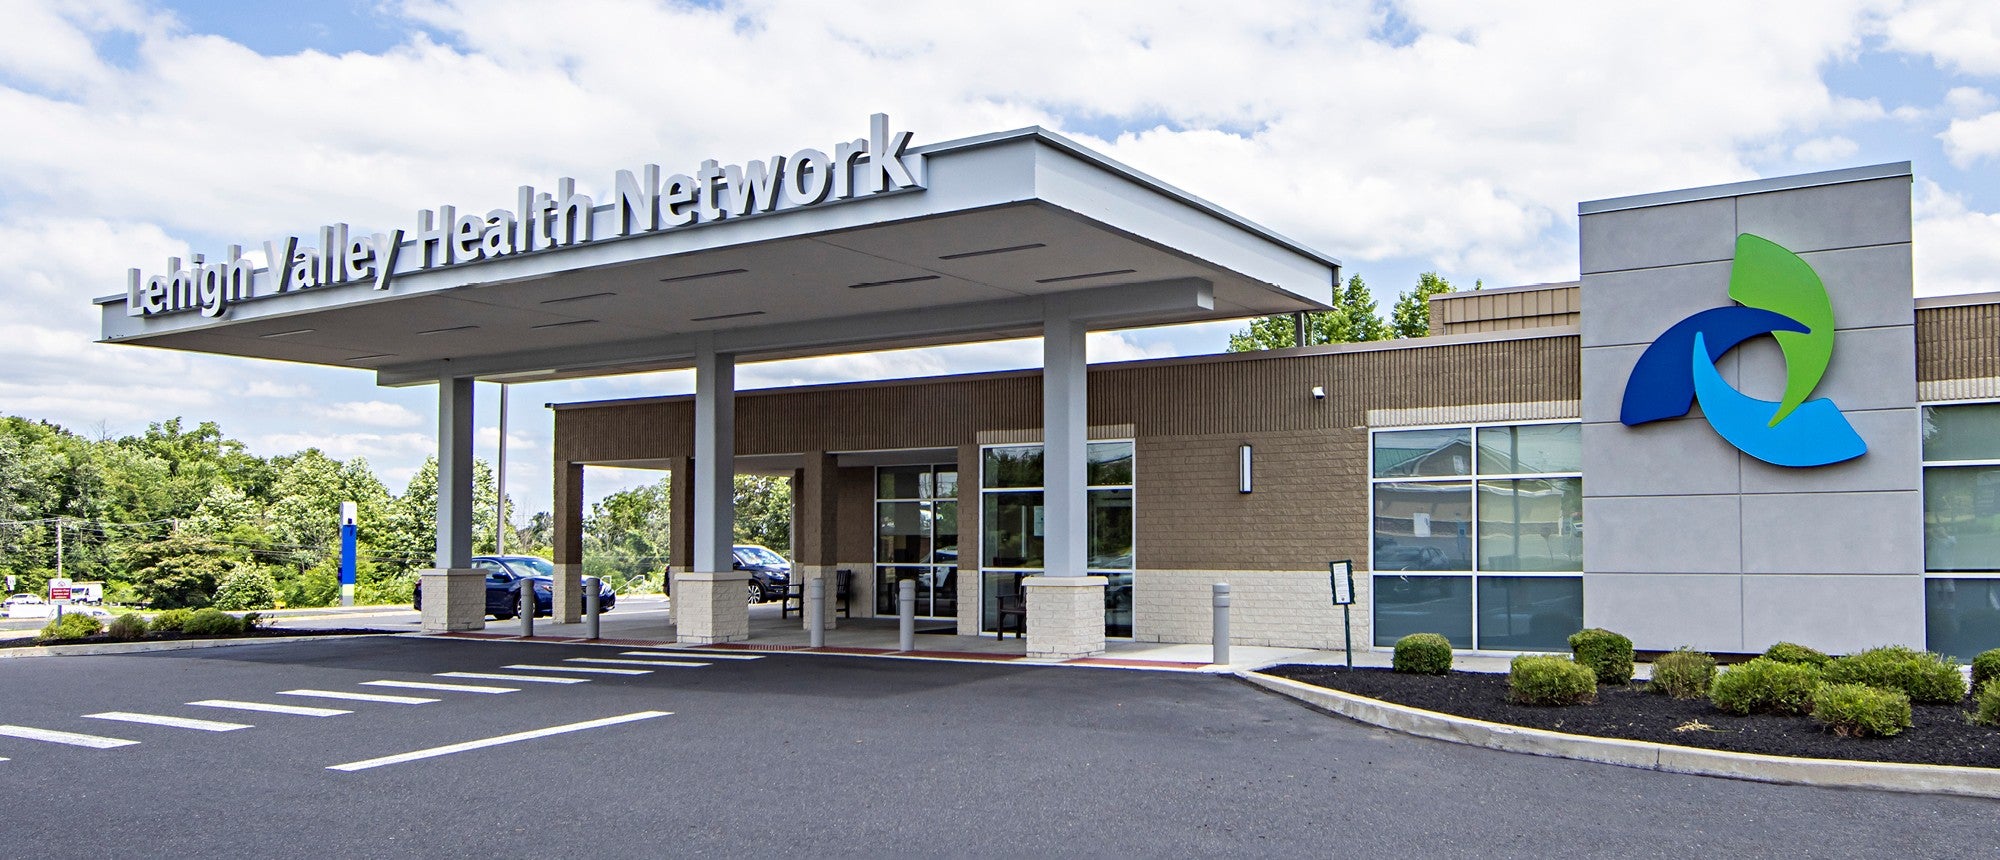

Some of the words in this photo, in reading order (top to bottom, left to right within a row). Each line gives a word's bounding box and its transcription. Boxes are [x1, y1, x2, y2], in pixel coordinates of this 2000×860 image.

[127, 245, 253, 317] Lehigh
[263, 223, 404, 291] Valley
[417, 177, 593, 268] Health
[615, 113, 920, 235] Network
